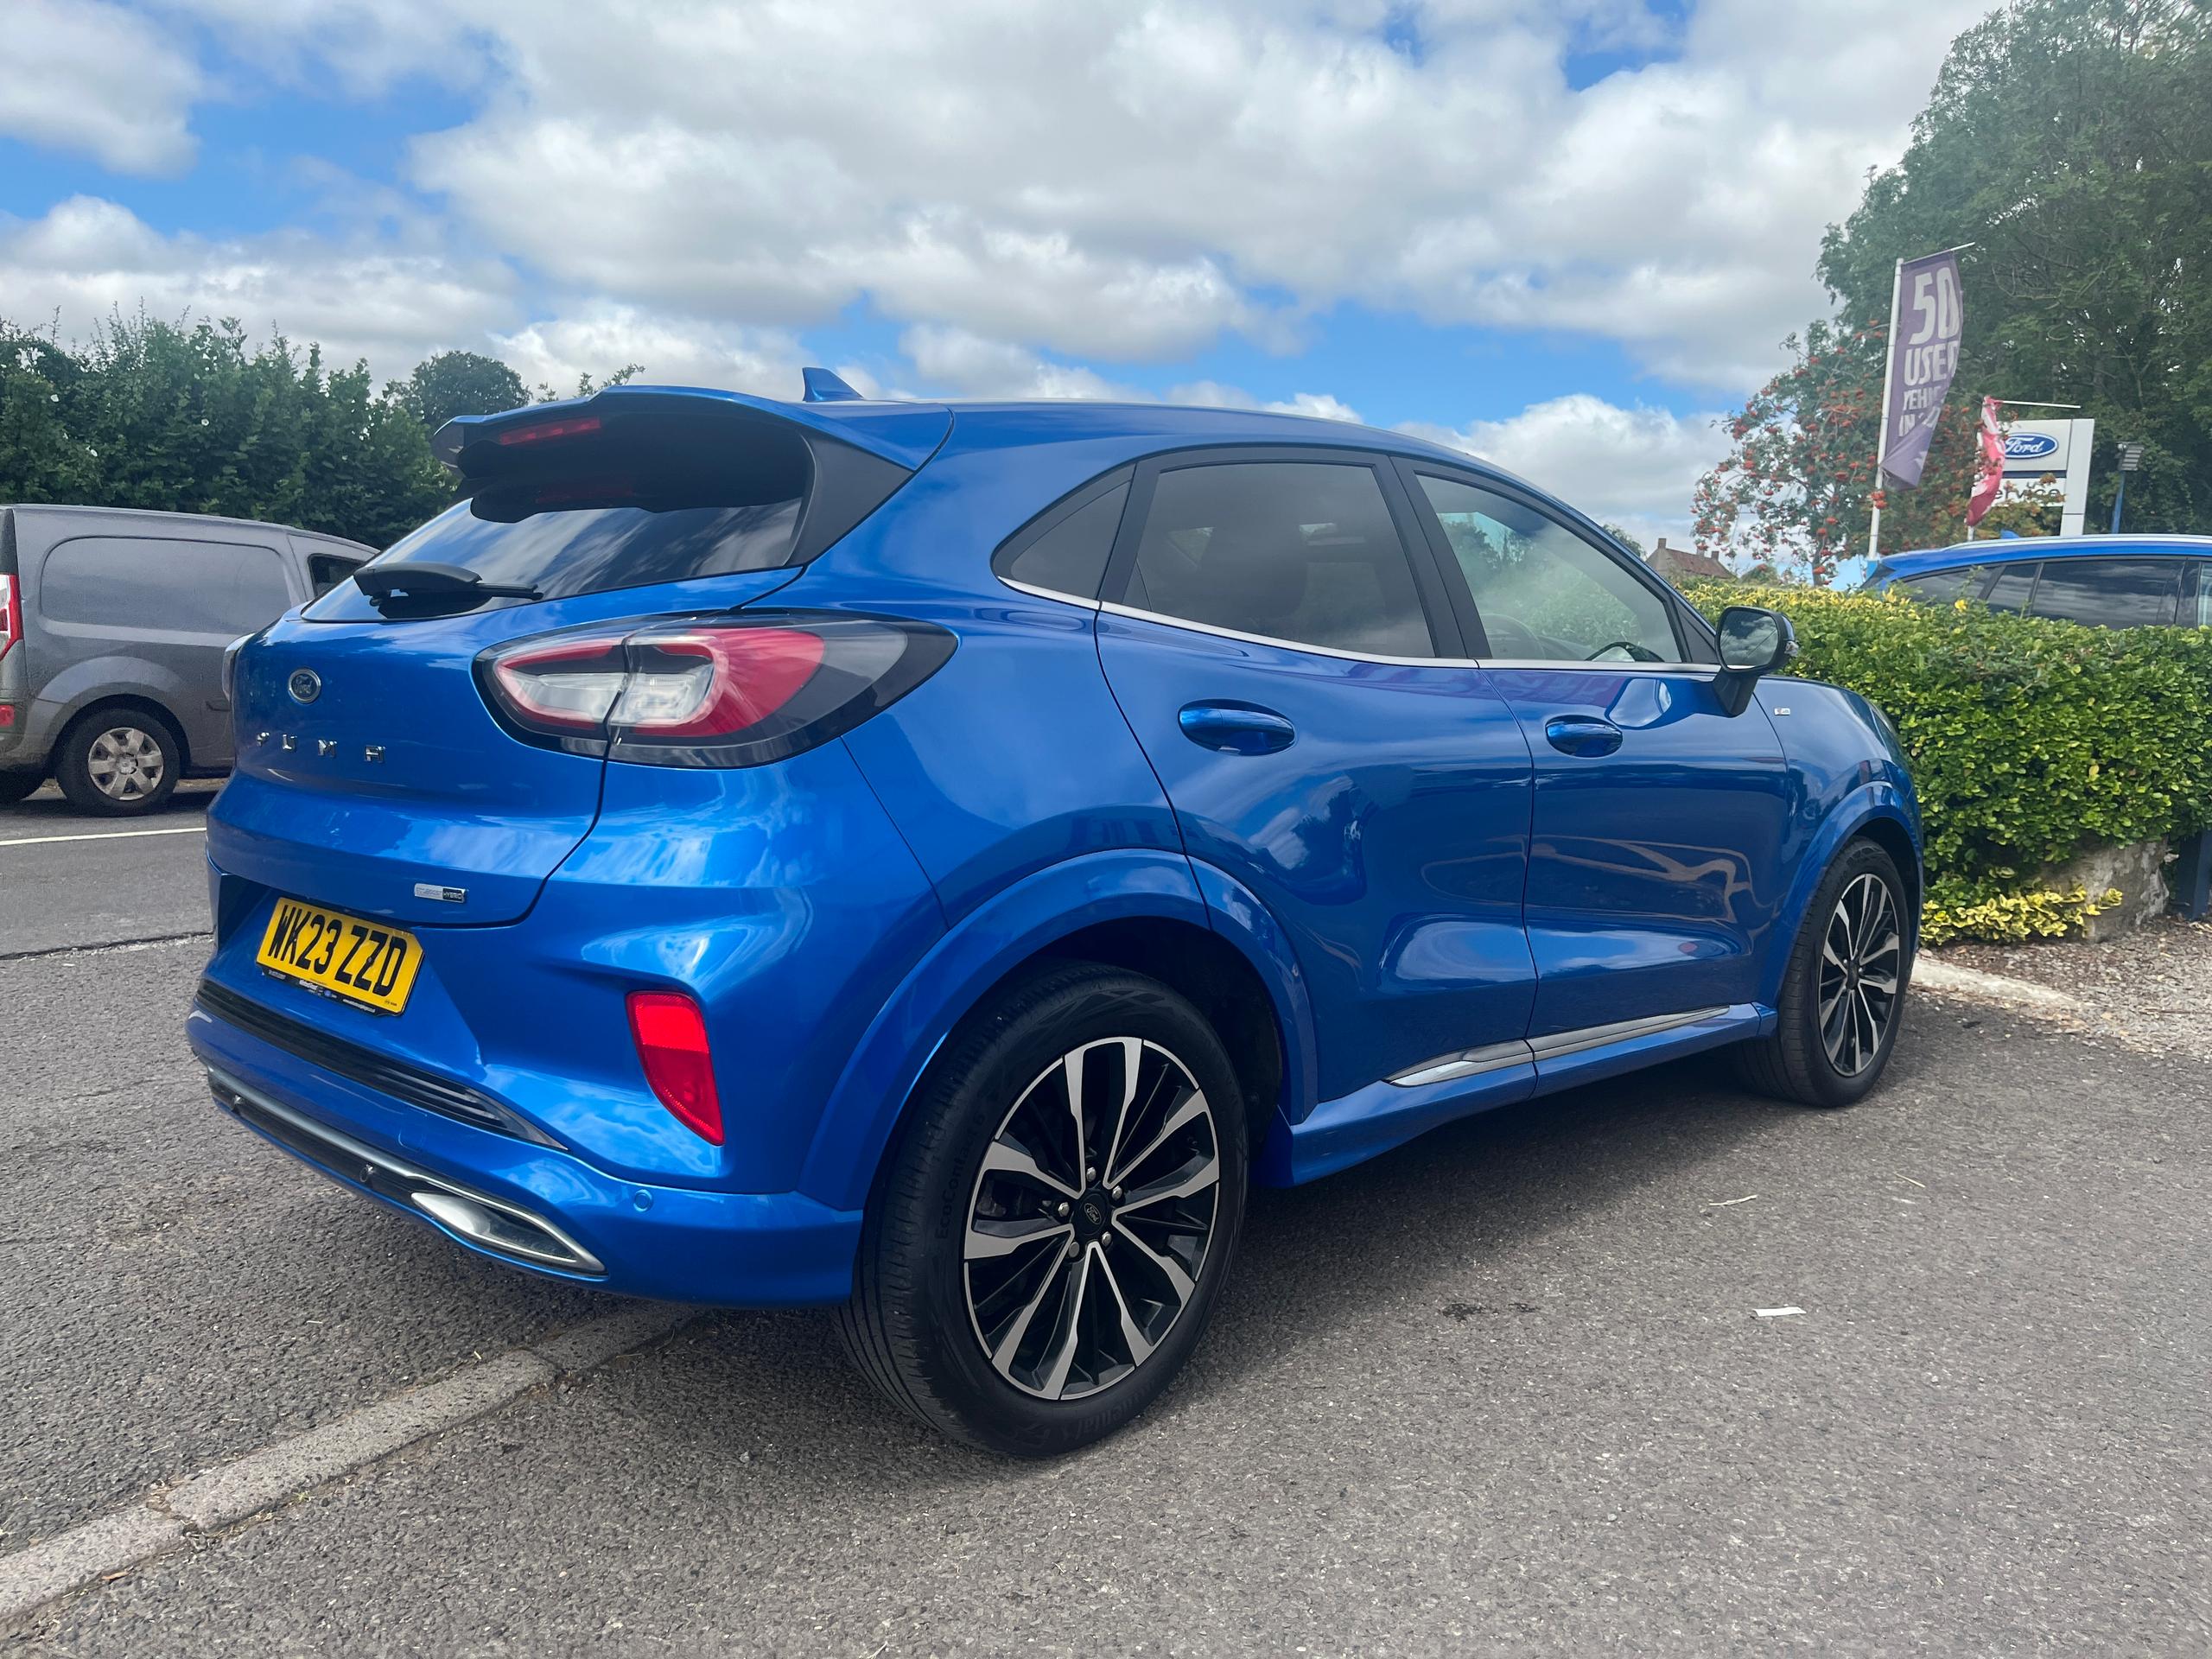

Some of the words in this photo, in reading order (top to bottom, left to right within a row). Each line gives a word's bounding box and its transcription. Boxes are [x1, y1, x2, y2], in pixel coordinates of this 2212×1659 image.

[1908, 267, 1961, 345] 50
[2005, 436, 2045, 454] Ford
[1993, 488, 2061, 501] ervce
[257, 731, 386, 764] PUMA
[267, 904, 343, 975] WK23
[334, 925, 407, 997] ZZD
